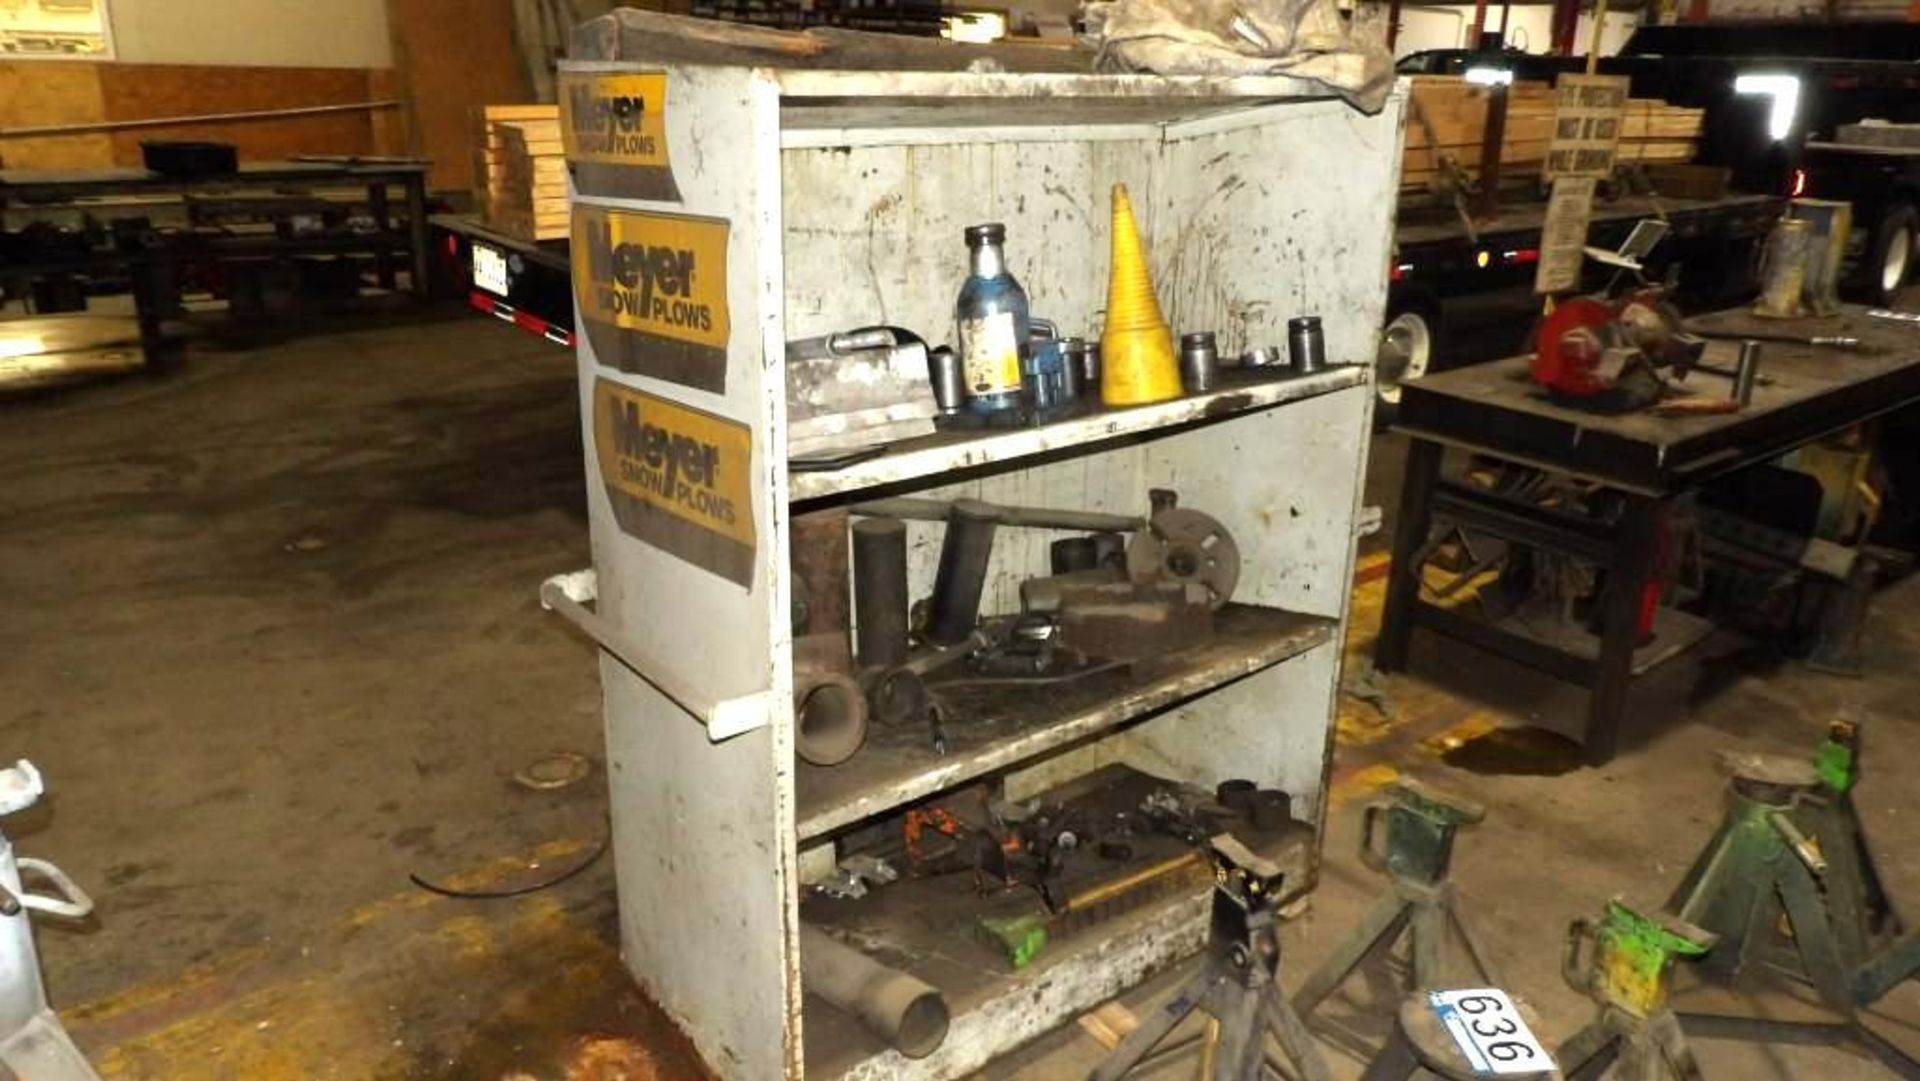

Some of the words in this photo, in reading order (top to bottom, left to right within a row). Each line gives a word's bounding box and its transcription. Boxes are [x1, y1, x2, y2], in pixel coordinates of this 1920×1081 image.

[568, 84, 645, 153] Meyer
[613, 134, 656, 155] PLOWS
[587, 219, 696, 319] Meyer
[652, 296, 712, 332] PLOWS
[610, 394, 720, 499] Meyer
[620, 458, 664, 496] SNOW
[675, 481, 736, 526] PLOWS
[1458, 996, 1535, 1061] 636
